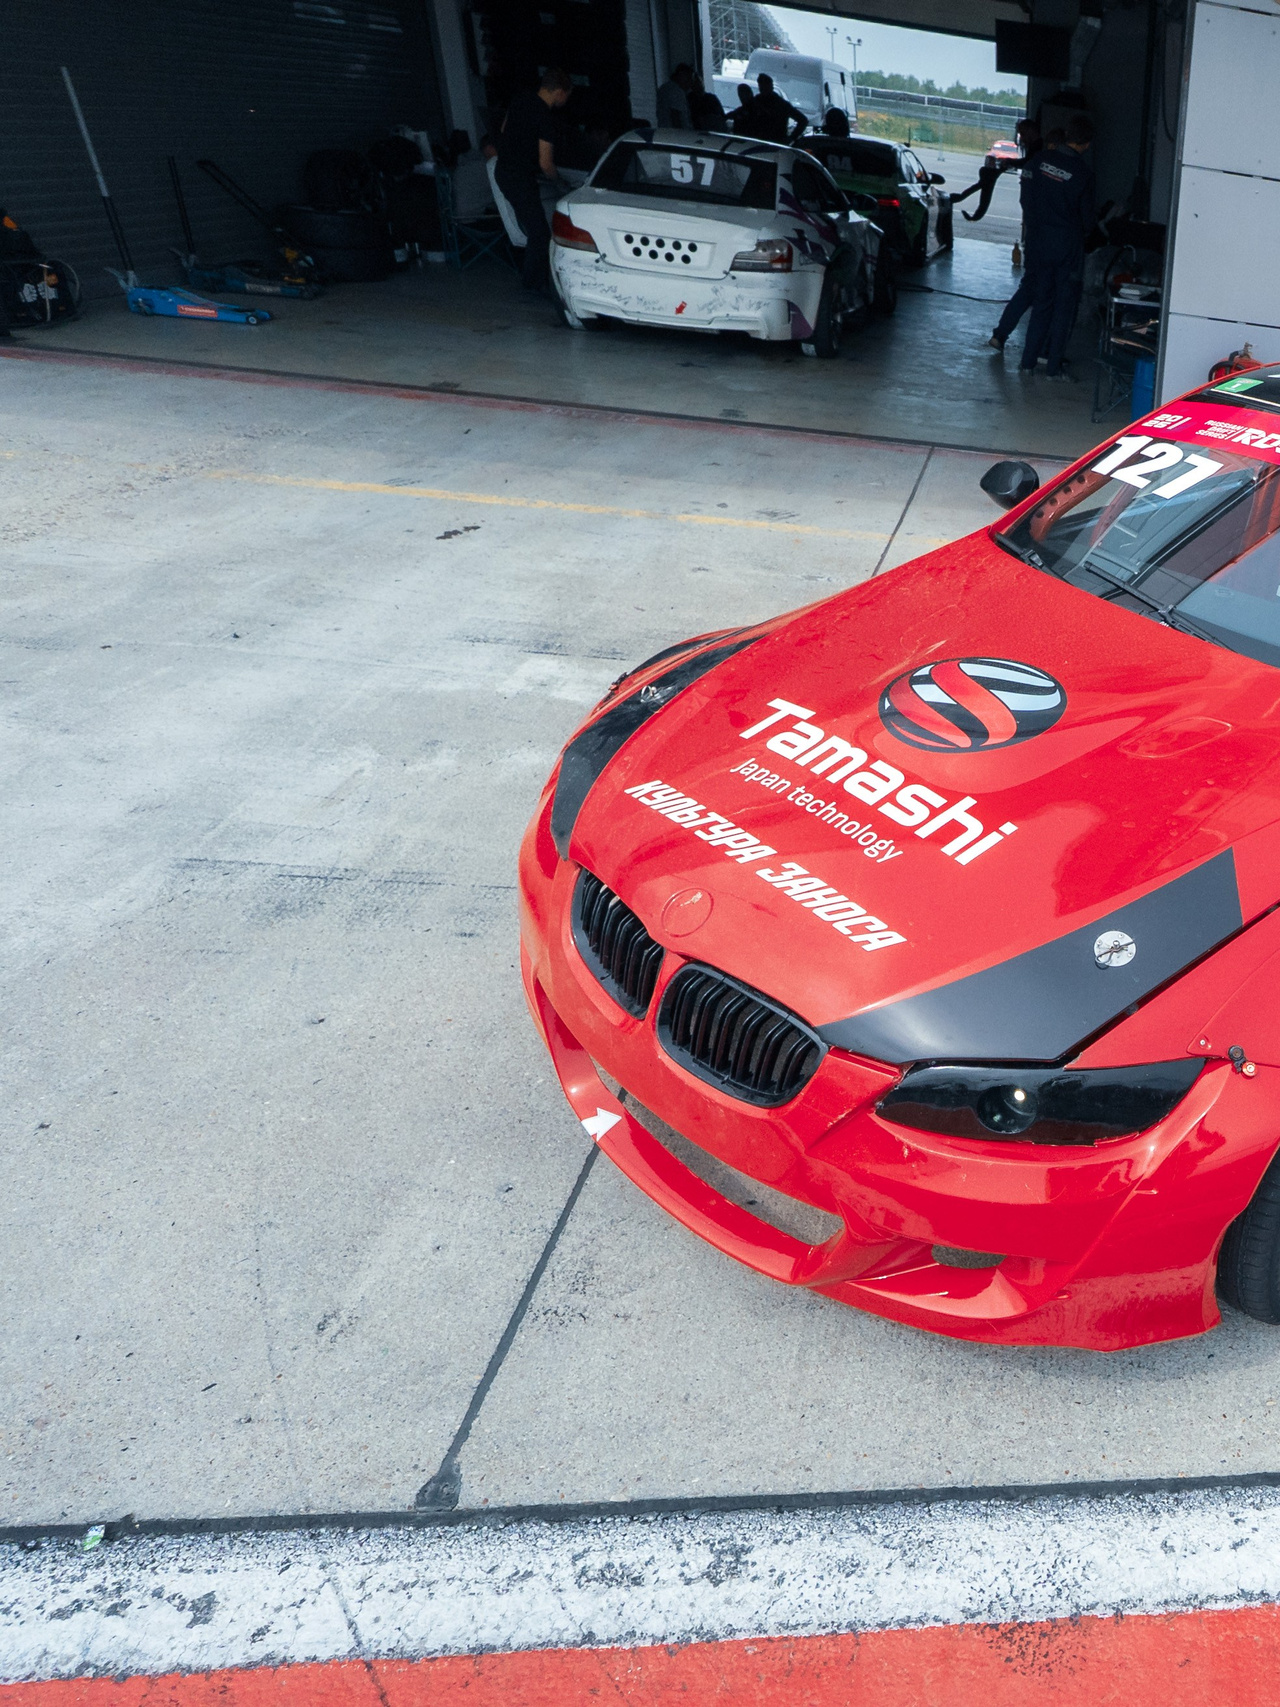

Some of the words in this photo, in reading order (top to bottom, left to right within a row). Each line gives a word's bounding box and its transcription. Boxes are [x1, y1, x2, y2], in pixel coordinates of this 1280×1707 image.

[670, 154, 715, 186] 57
[1195, 429, 1225, 440] SERIES
[1204, 419, 1243, 431] RUSSIAN
[1210, 426, 1236, 435] DRIFT
[1090, 434, 1224, 500] 127
[739, 698, 1019, 867] Tamashi
[730, 757, 791, 795] Japan
[786, 784, 904, 864] technology
[624, 779, 779, 865] КУЛЬТУРА
[756, 862, 908, 953] ЗАНОСА
